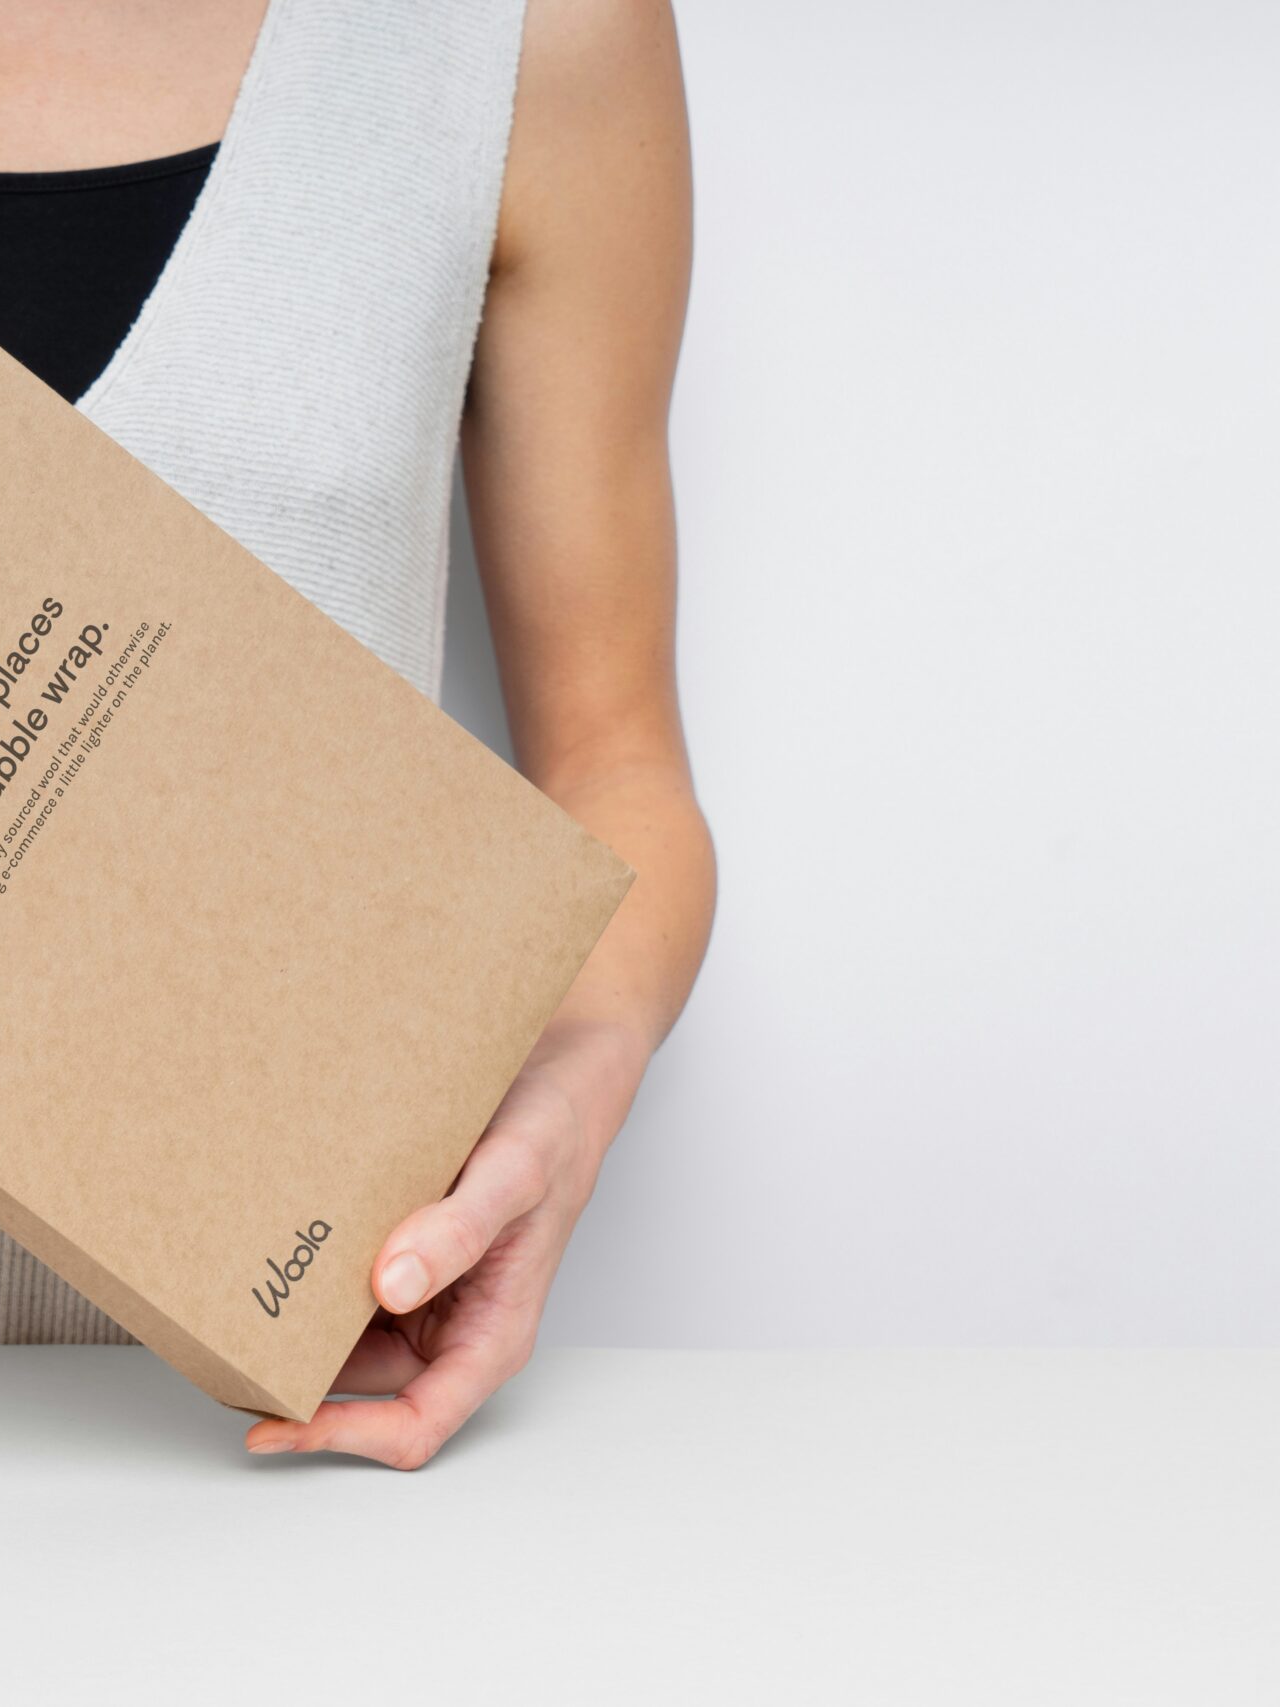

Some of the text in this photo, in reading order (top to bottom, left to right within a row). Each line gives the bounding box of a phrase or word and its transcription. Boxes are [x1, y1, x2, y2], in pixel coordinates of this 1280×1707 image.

[40, 623, 110, 705] wrap.
[139, 621, 173, 668] planet.
[111, 690, 128, 709] on
[122, 665, 142, 689] the
[3, 788, 42, 845] sourced
[37, 755, 63, 789] wool
[57, 726, 83, 757] that
[77, 684, 108, 727] would
[105, 621, 150, 686] otherwise
[79, 707, 114, 754] lighter
[54, 787, 65, 798] a
[58, 753, 86, 787] little
[1, 798, 58, 880] e-commerce
[251, 1219, 333, 1318] Woola
